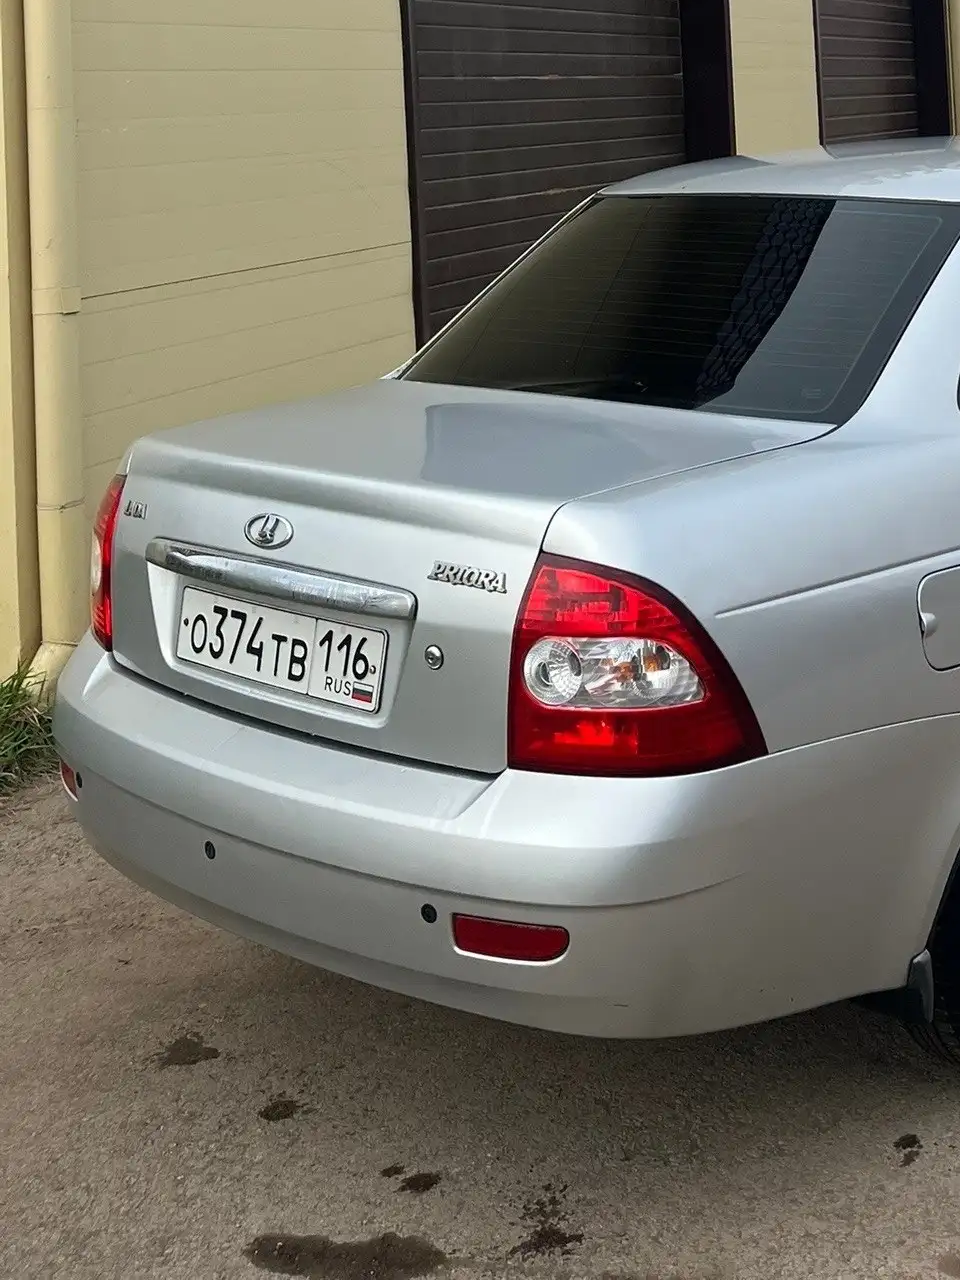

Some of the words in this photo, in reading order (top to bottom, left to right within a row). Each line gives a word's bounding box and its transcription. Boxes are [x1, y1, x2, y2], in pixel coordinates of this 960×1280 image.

[427, 560, 507, 594] PRIORA
[319, 629, 370, 680] 116
[324, 676, 351, 696] RUS
